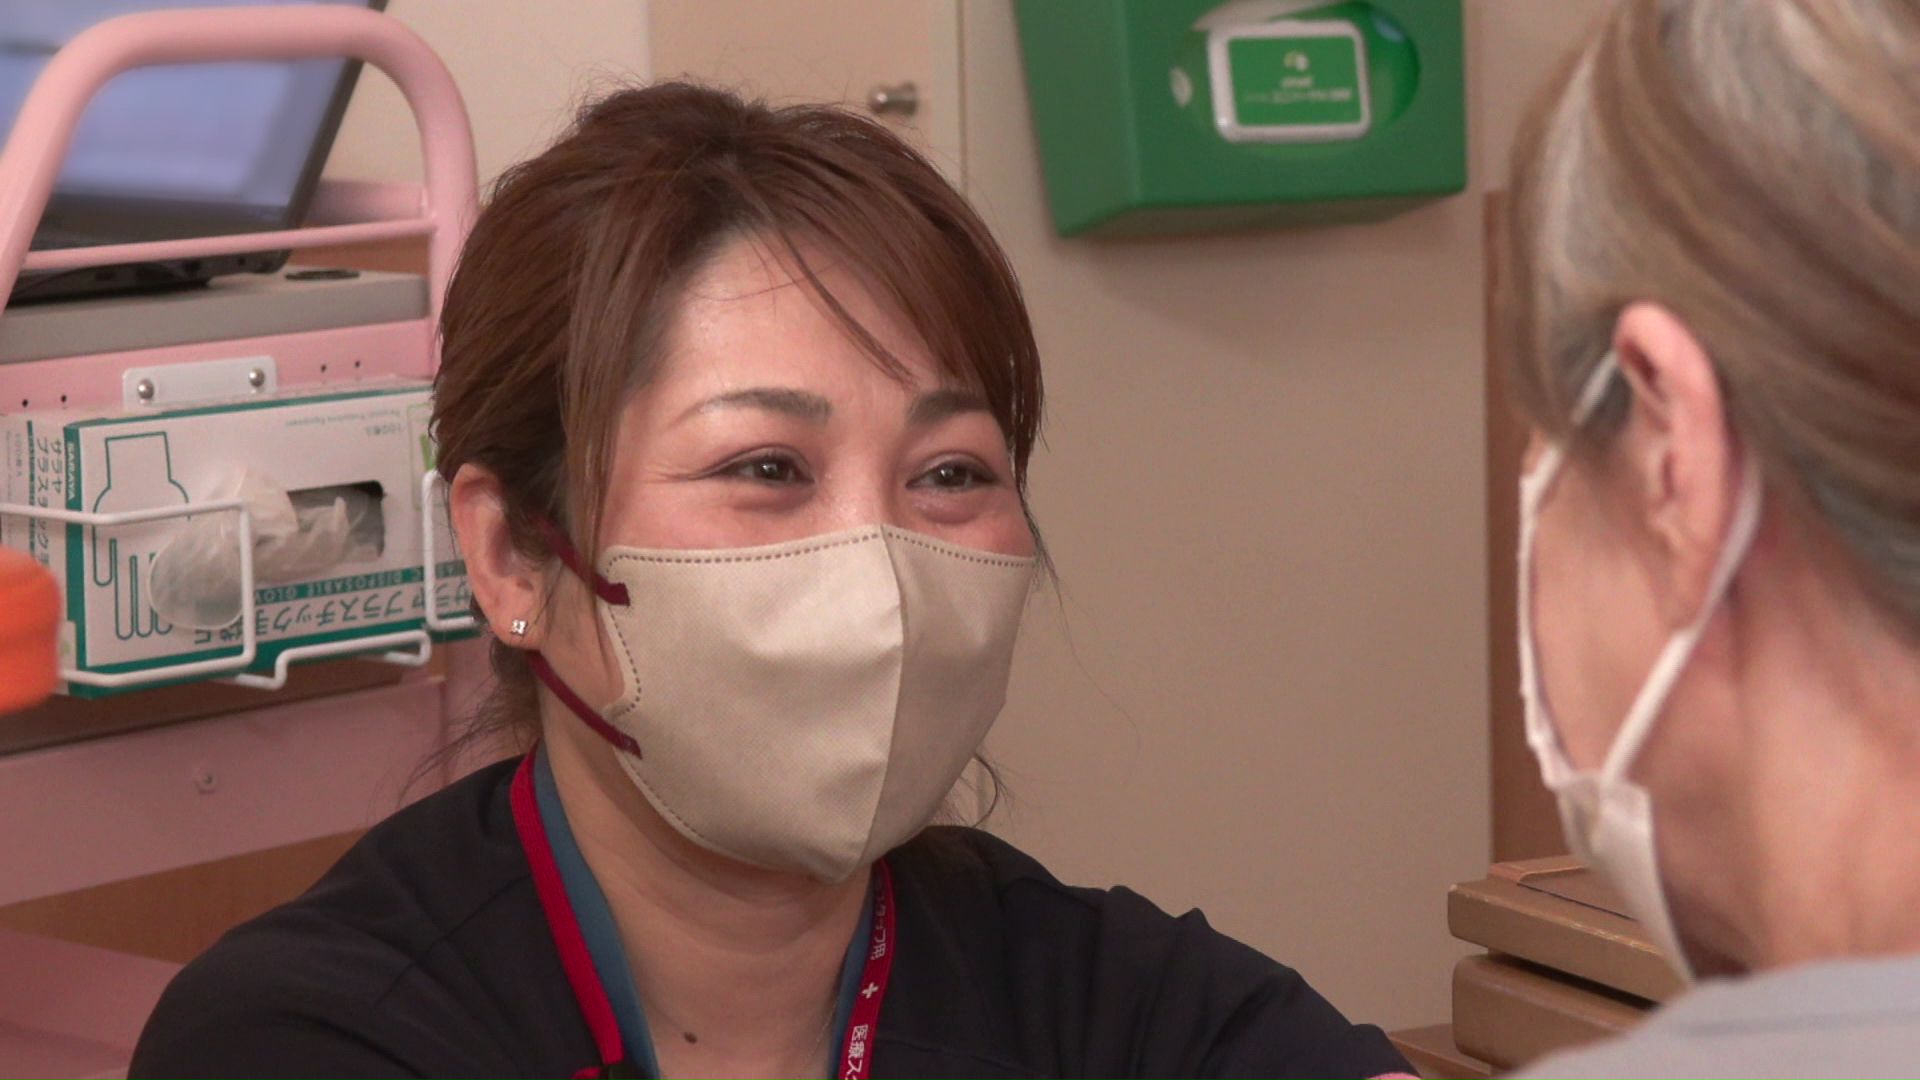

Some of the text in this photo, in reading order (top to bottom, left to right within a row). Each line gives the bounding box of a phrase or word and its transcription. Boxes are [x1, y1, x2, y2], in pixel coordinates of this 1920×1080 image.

[51, 439, 63, 494] サラヤ
[66, 442, 76, 500] SARAYA
[255, 573, 402, 602] DISPOSABLE GLOV
